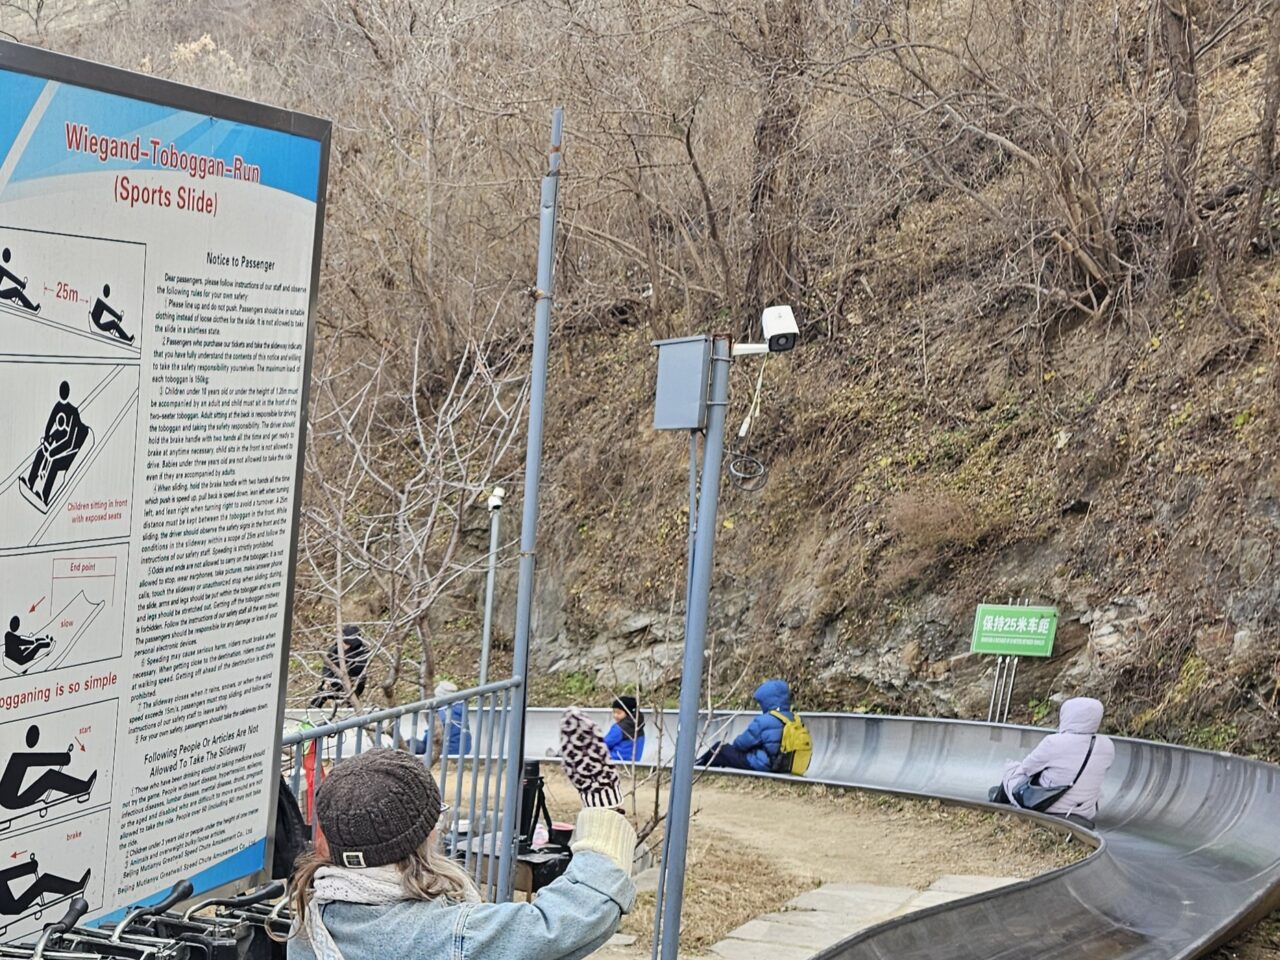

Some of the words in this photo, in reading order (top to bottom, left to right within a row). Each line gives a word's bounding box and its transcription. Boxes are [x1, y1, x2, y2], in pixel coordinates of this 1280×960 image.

[65, 121, 261, 184] Wiegand-Toboggan-Run
[114, 175, 172, 208] (Sports
[177, 187, 218, 217] Slide)
[207, 252, 230, 267] Notice
[232, 257, 240, 267] to
[241, 256, 275, 272] Passenger
[56, 282, 79, 303] 25m
[67, 501, 88, 512] Children
[89, 500, 107, 511] sitting
[108, 500, 114, 508] in
[115, 499, 128, 508] front
[72, 513, 84, 523] with
[85, 512, 106, 523] exposed
[107, 512, 122, 521] seats
[70, 563, 80, 572] End
[82, 563, 96, 574] point
[60, 618, 74, 628] slow
[983, 615, 1050, 633] 保持25米车距
[56, 683, 65, 697] is
[68, 681, 80, 694] so
[83, 672, 117, 695] simple
[79, 725, 91, 735] start
[144, 748, 177, 765] Following
[179, 741, 201, 754] People
[202, 737, 210, 748] Or
[212, 732, 235, 745] Articles
[236, 728, 247, 738] Are
[248, 724, 259, 735] Not
[149, 760, 178, 778] Allowed
[179, 758, 187, 769] To
[189, 754, 204, 766] Take
[206, 750, 217, 761] The
[219, 743, 246, 758] Slideway
[66, 831, 82, 841] brake
